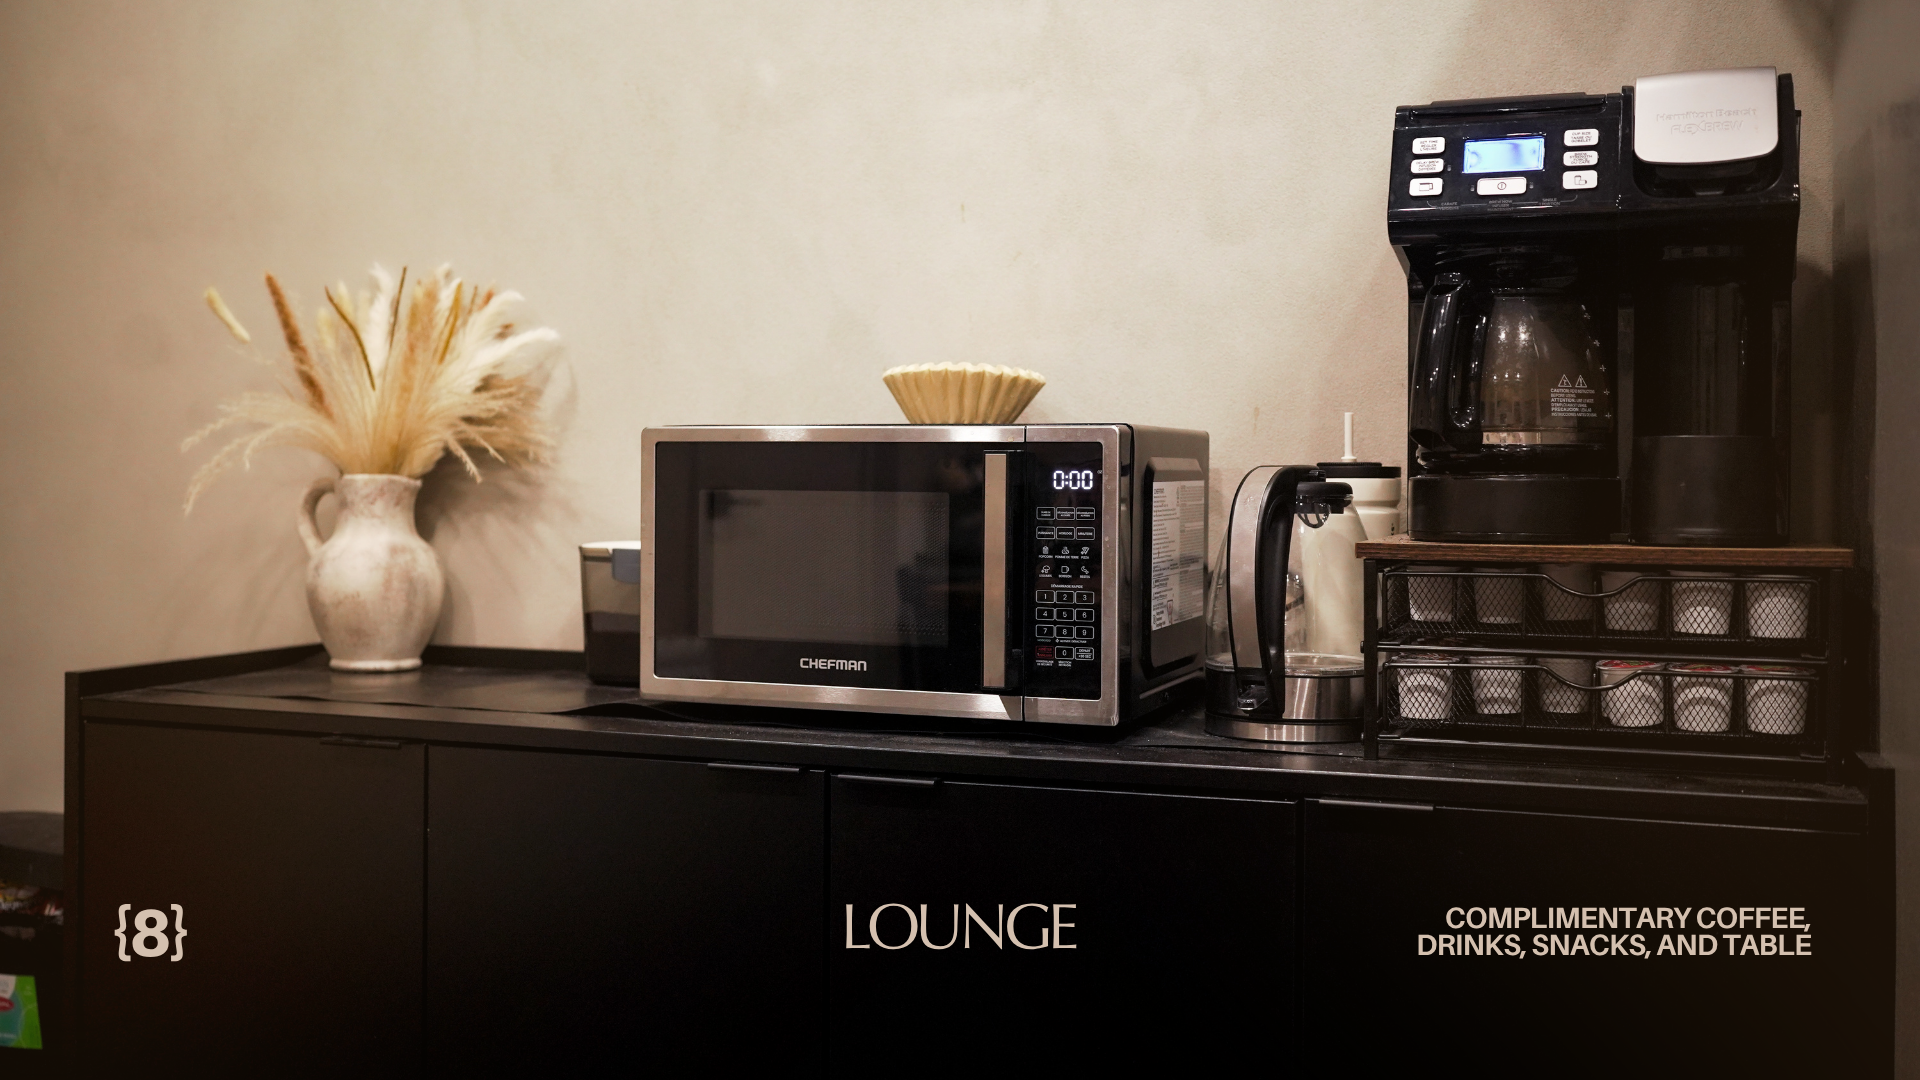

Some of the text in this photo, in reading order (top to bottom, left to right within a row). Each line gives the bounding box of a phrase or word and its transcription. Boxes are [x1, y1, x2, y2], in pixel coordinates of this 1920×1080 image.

[1671, 120, 1744, 134] FLEXBREW
[1054, 470, 1093, 490] 0:00
[800, 658, 866, 671] CHEFMAN
